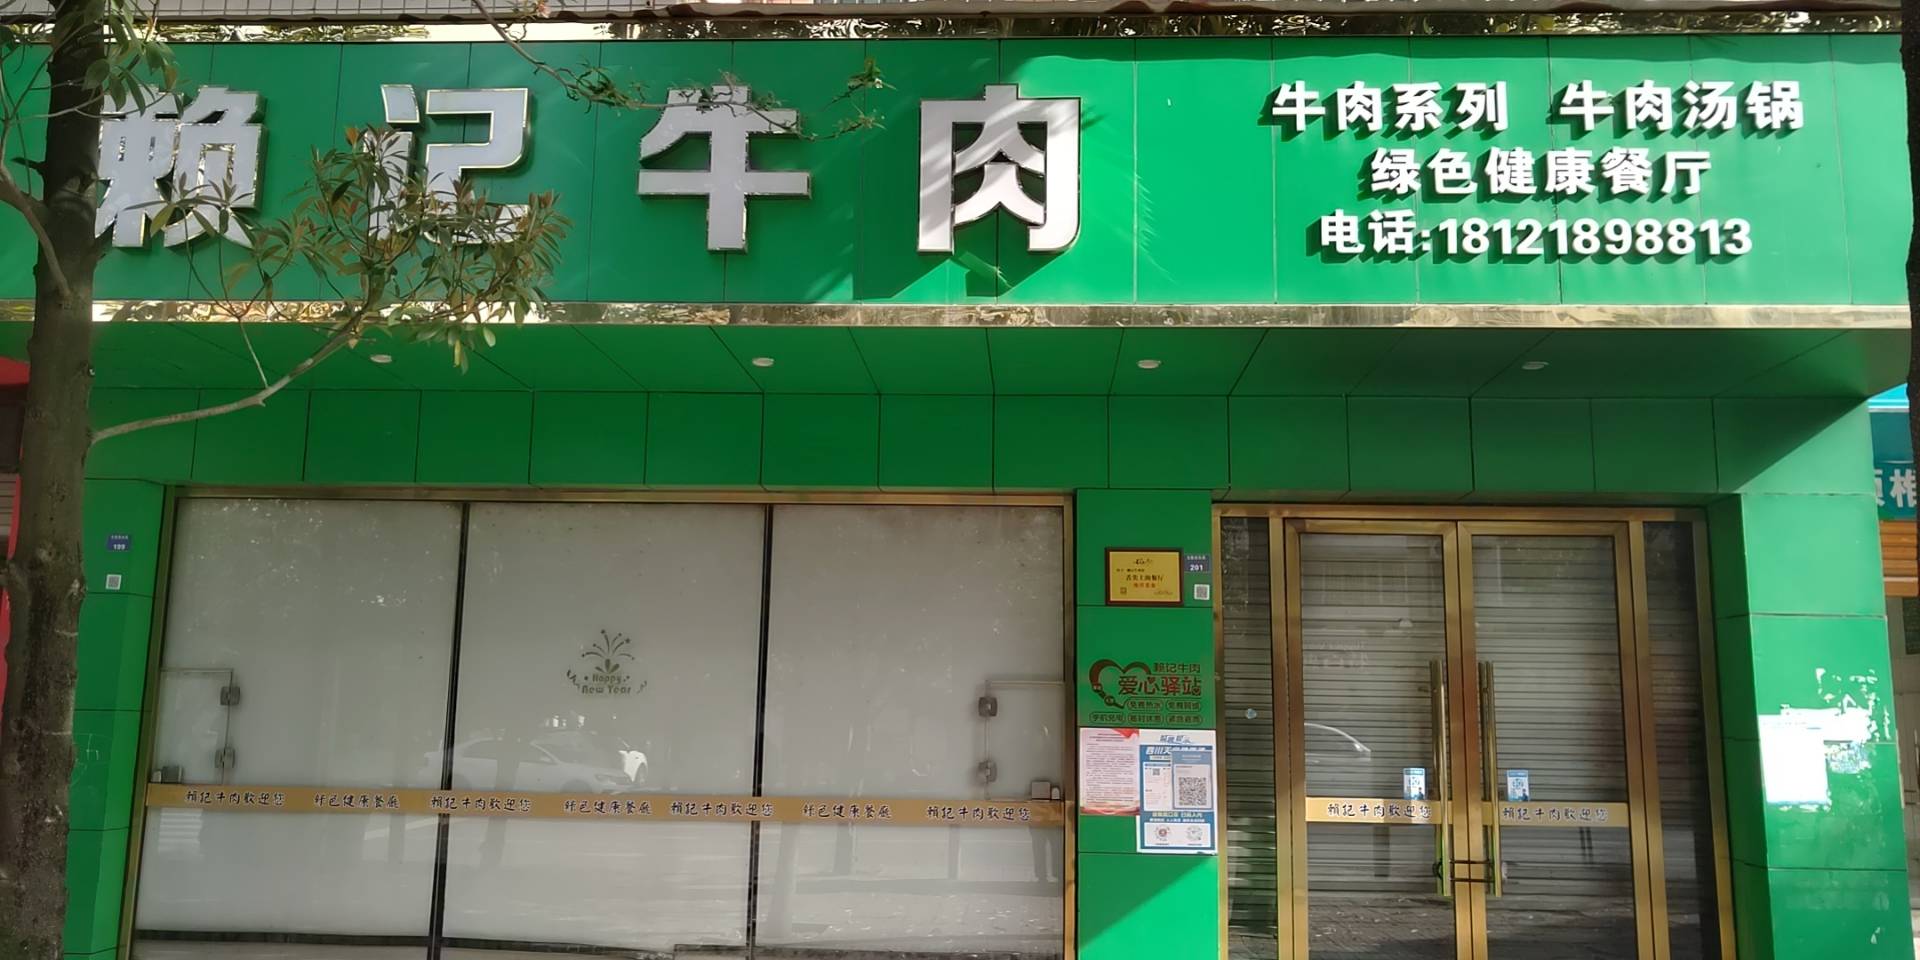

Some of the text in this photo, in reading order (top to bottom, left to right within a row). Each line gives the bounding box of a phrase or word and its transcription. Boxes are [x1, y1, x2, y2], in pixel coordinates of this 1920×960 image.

[1271, 79, 1804, 132] 牛肉系列 牛肉汤锅
[1370, 146, 1712, 196] 绿色健康餐厅
[1320, 210, 1753, 257] 电话:18121898813
[1189, 563, 1204, 572] 201
[1118, 675, 1202, 696] 爱心驿站
